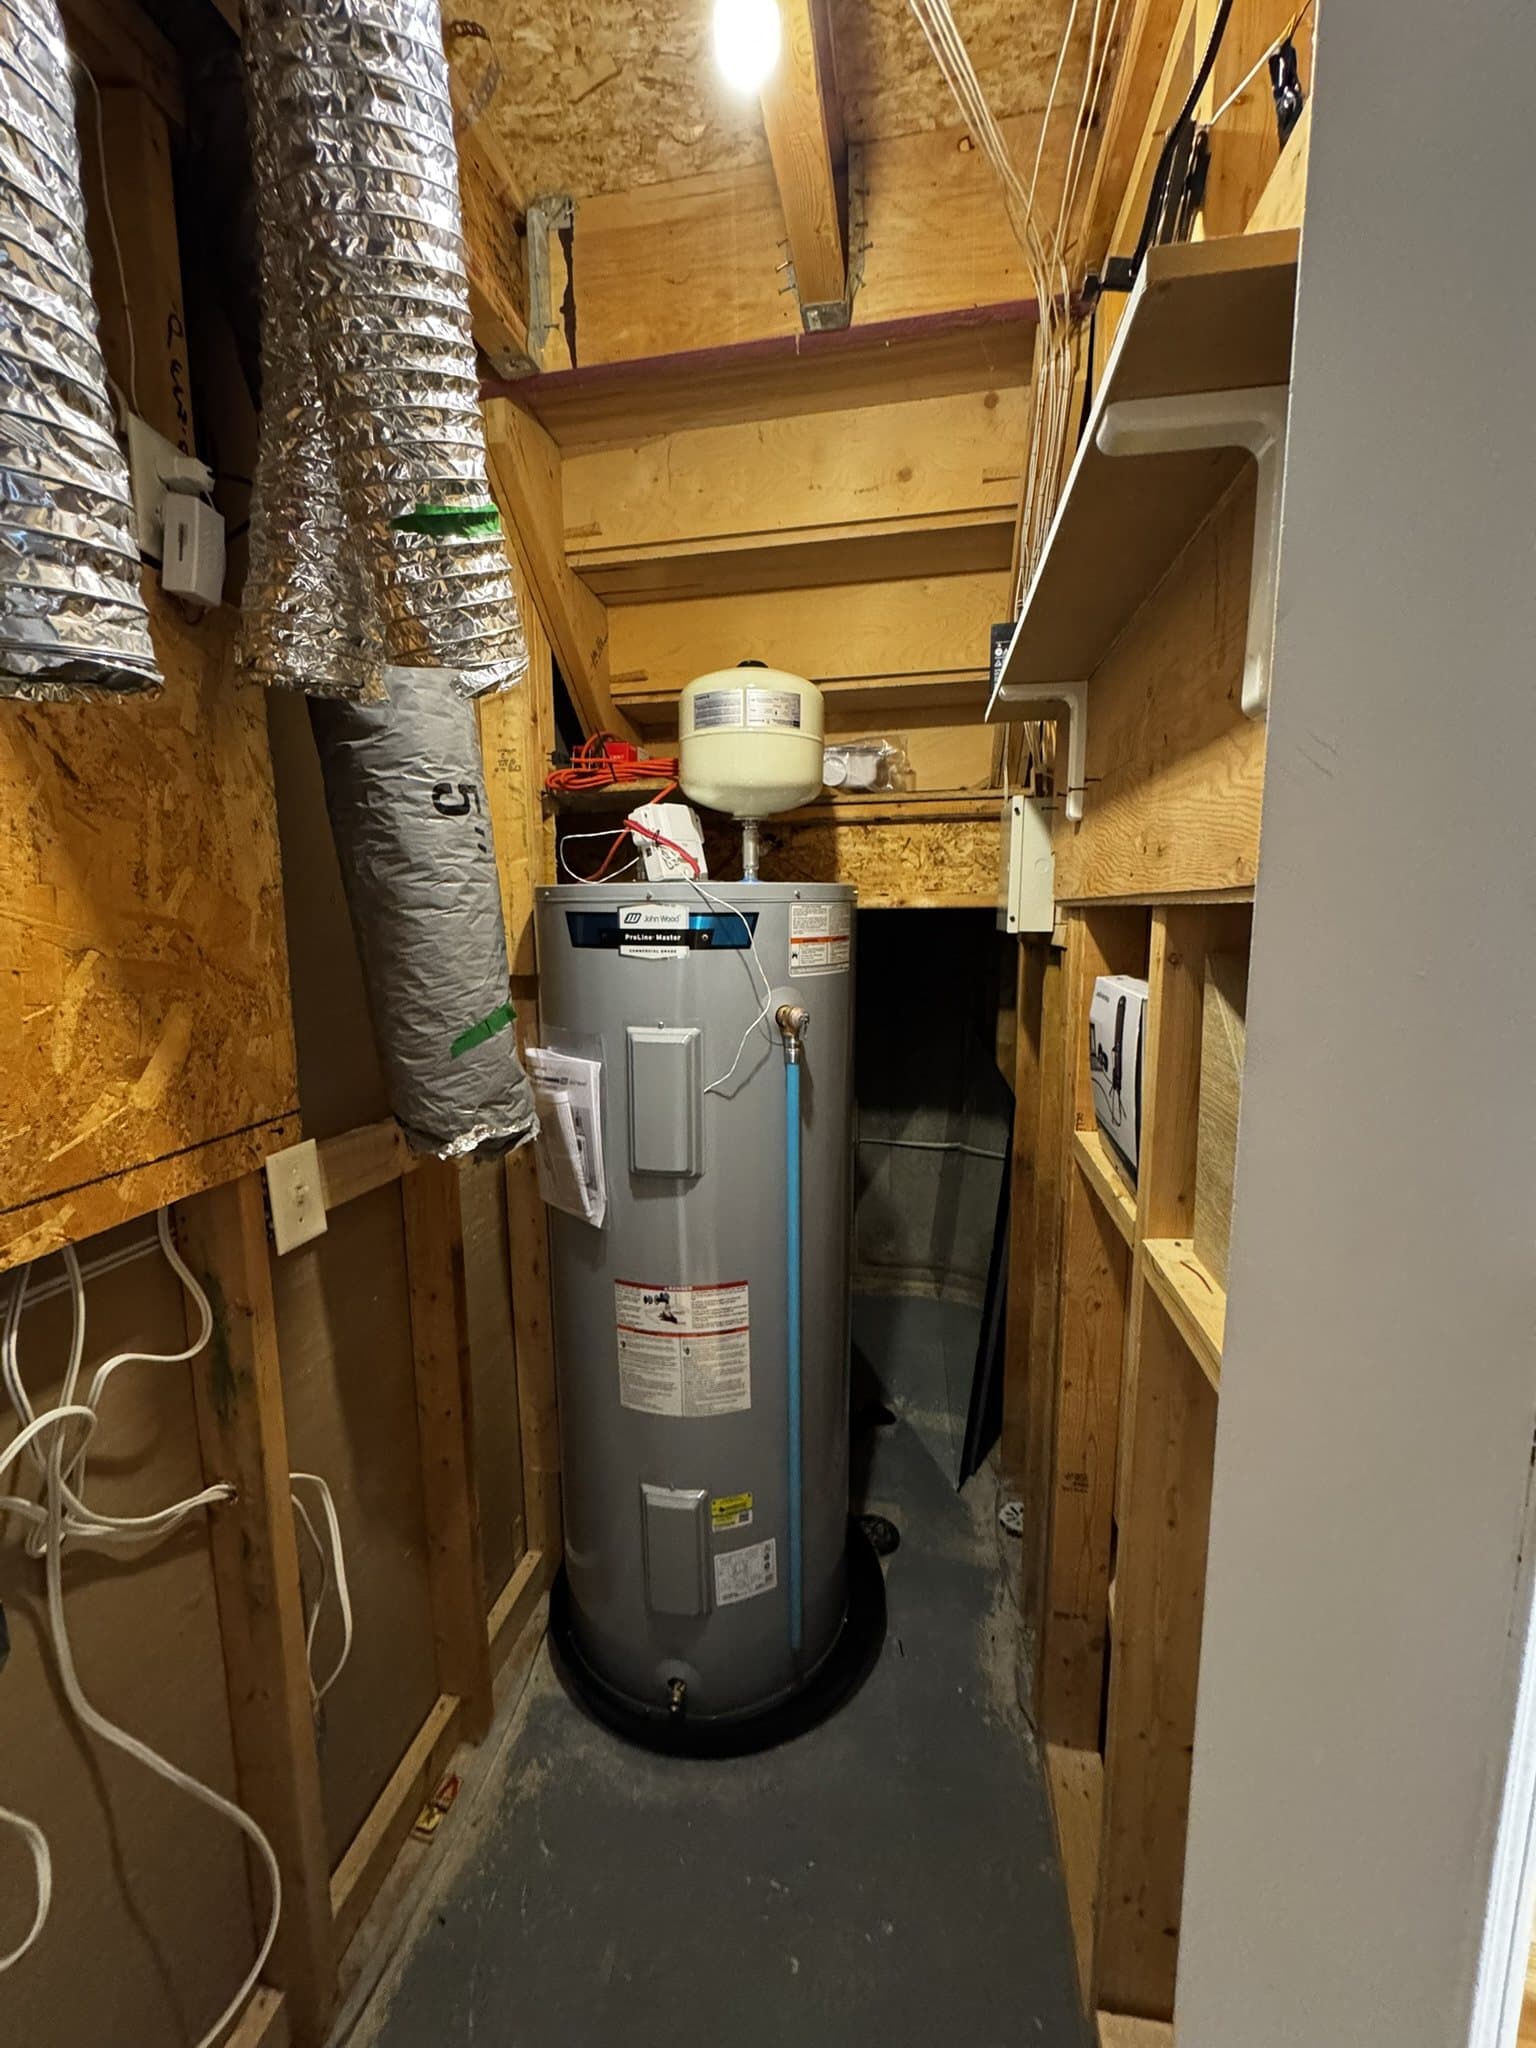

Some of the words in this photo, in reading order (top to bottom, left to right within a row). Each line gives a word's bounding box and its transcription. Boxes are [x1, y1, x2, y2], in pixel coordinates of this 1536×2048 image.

[643, 914, 659, 923] John
[660, 914, 681, 923] Wood
[624, 933, 652, 941] ProLine
[655, 933, 681, 941] Master
